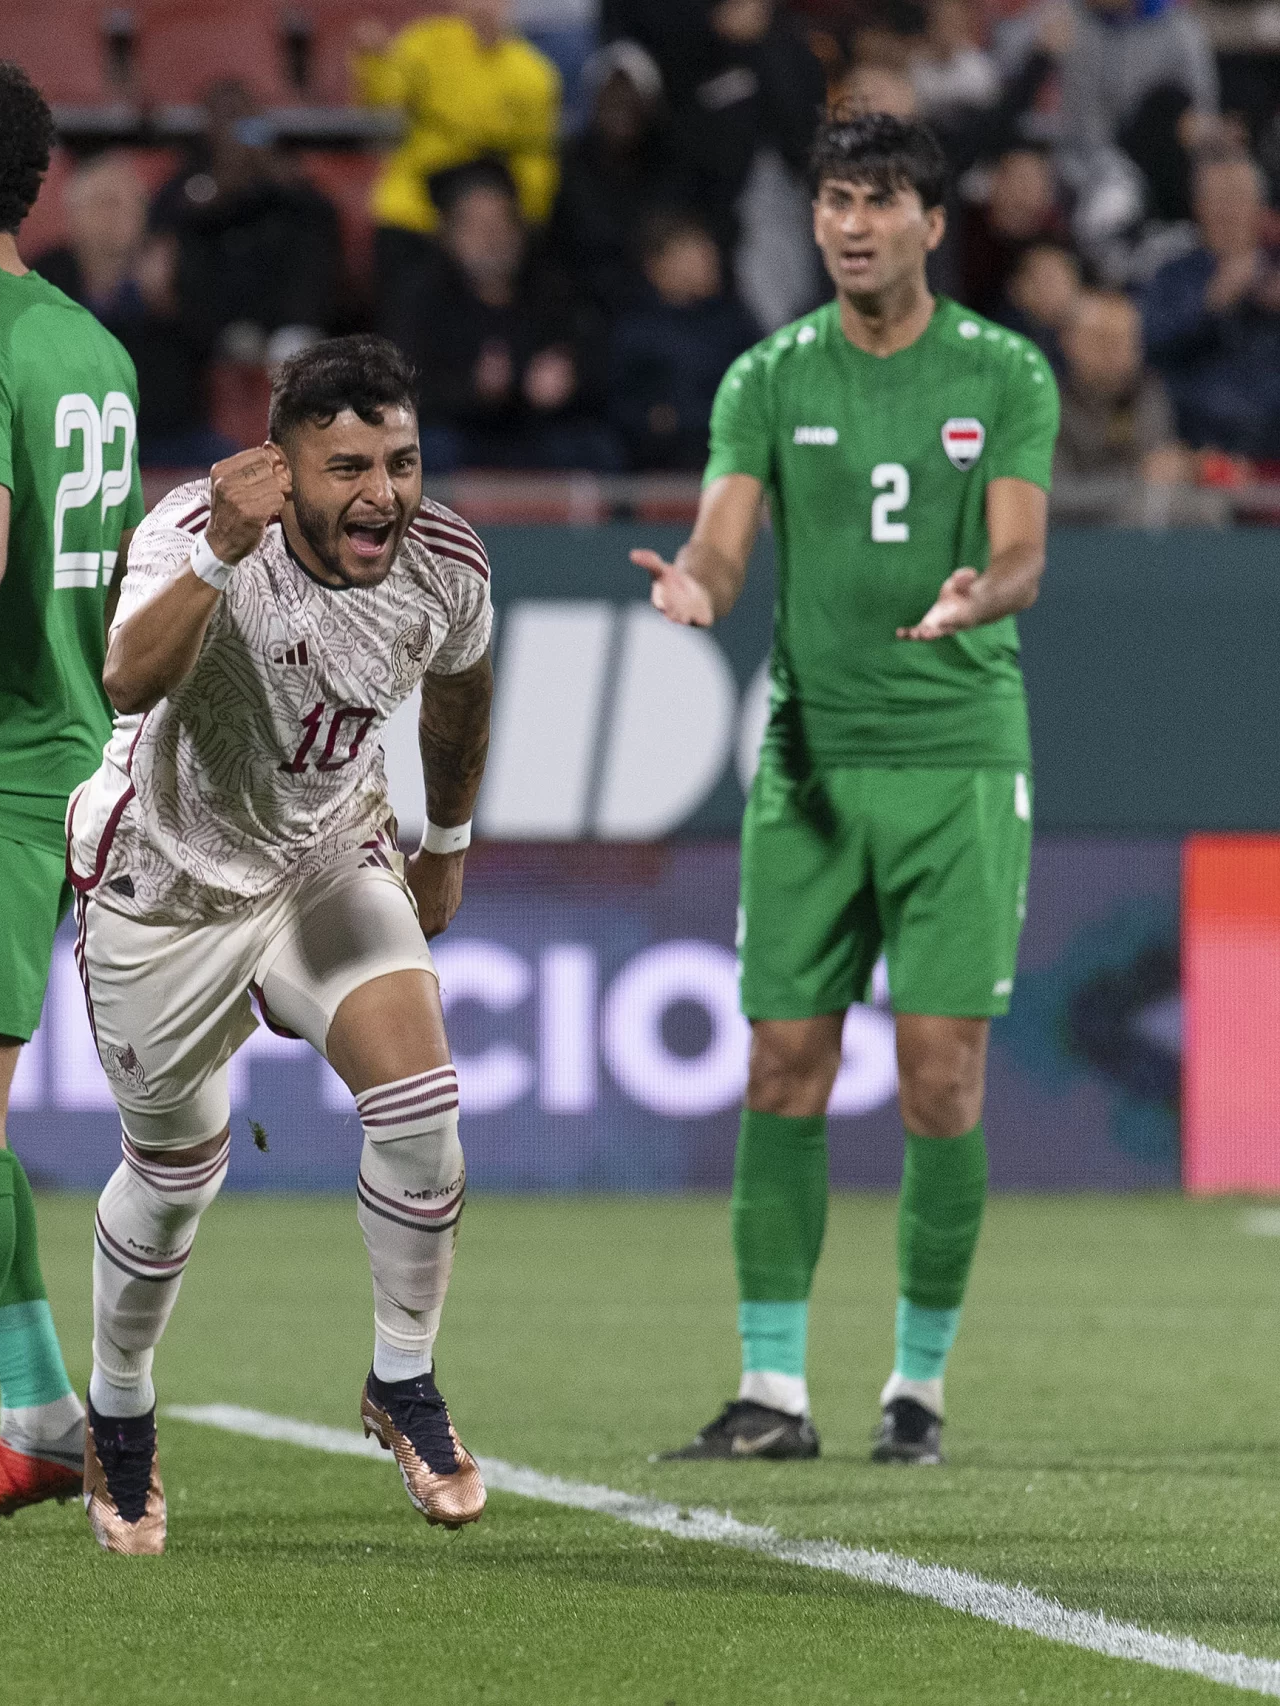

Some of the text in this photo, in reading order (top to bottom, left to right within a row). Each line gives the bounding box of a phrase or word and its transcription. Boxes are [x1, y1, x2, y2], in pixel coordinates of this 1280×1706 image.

[53, 391, 137, 589] 22
[871, 462, 910, 542] 2
[276, 702, 378, 773] 10
[403, 1169, 464, 1200] MEXICO
